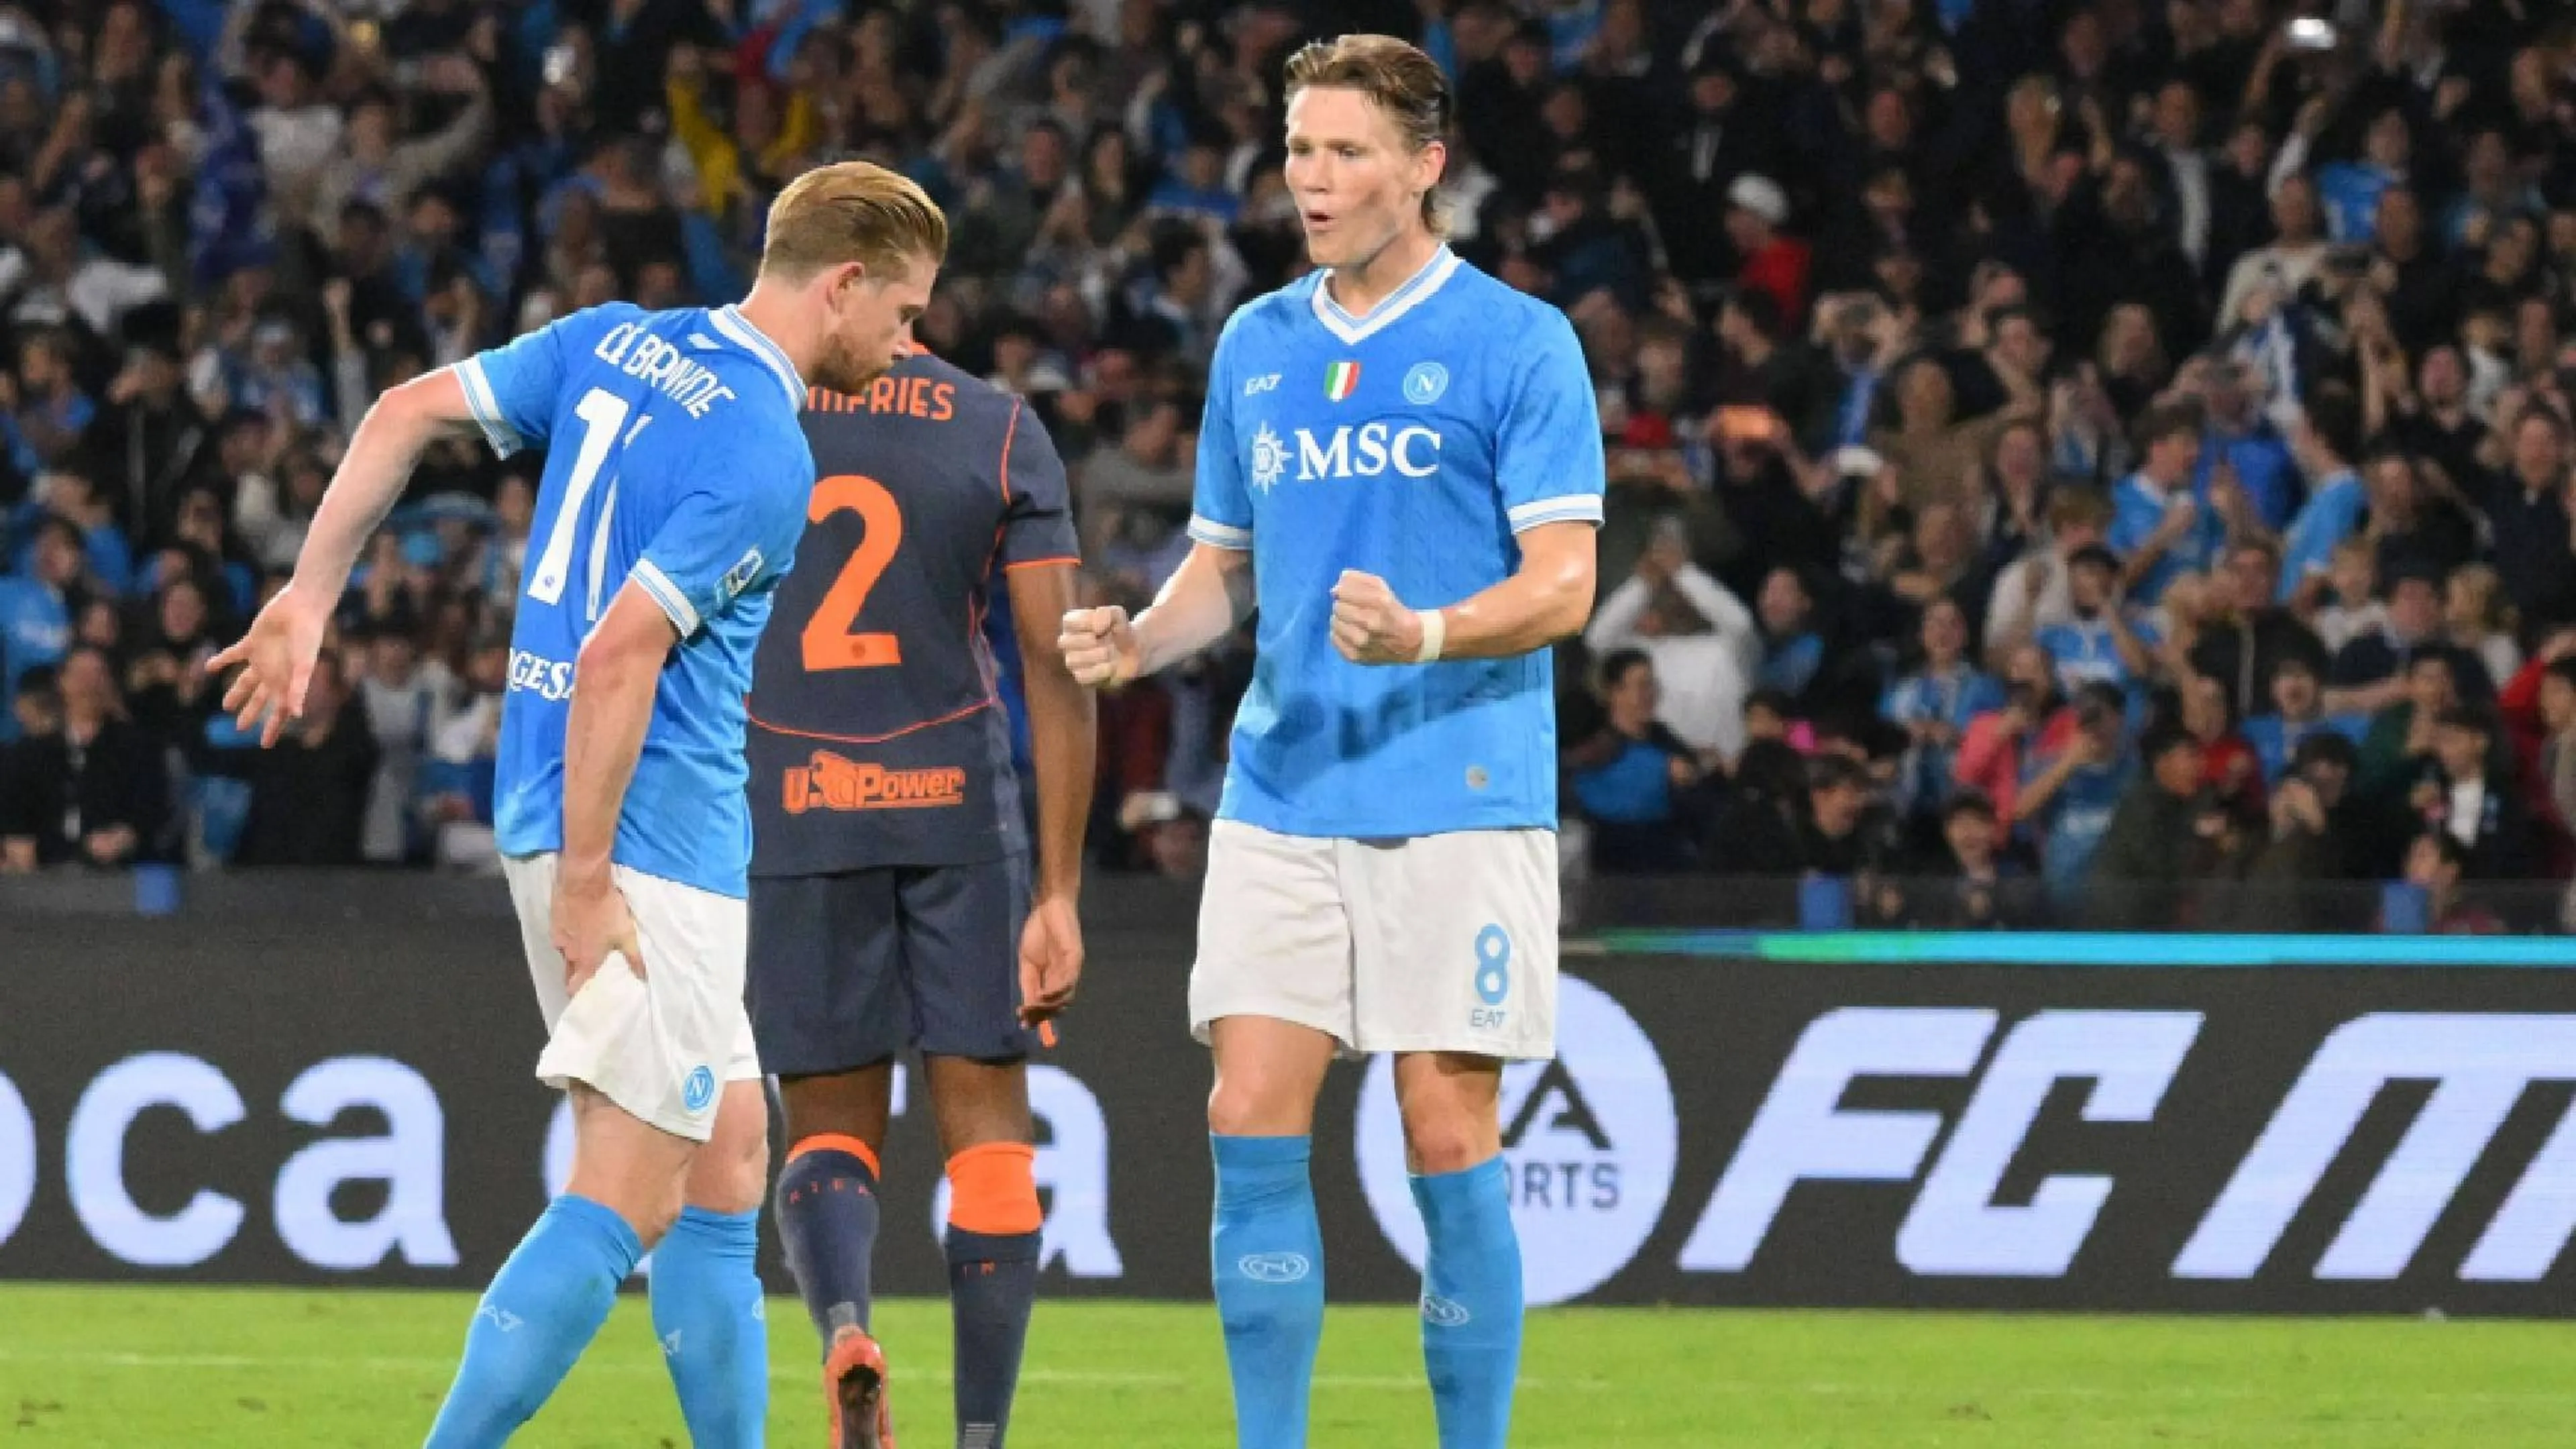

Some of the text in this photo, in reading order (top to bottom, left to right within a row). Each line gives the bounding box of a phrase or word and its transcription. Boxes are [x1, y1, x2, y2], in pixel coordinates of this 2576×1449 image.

[623, 334, 737, 419] BRNE
[1294, 428, 1441, 480] MSC
[801, 474, 902, 672] 2
[508, 647, 576, 701] GES
[1474, 923, 1510, 1005] 8
[1470, 1008, 1505, 1029] EA7
[0, 1050, 460, 1271] ca
[1677, 1006, 2206, 1276] FC
[1503, 1162, 1619, 1210] RTS
